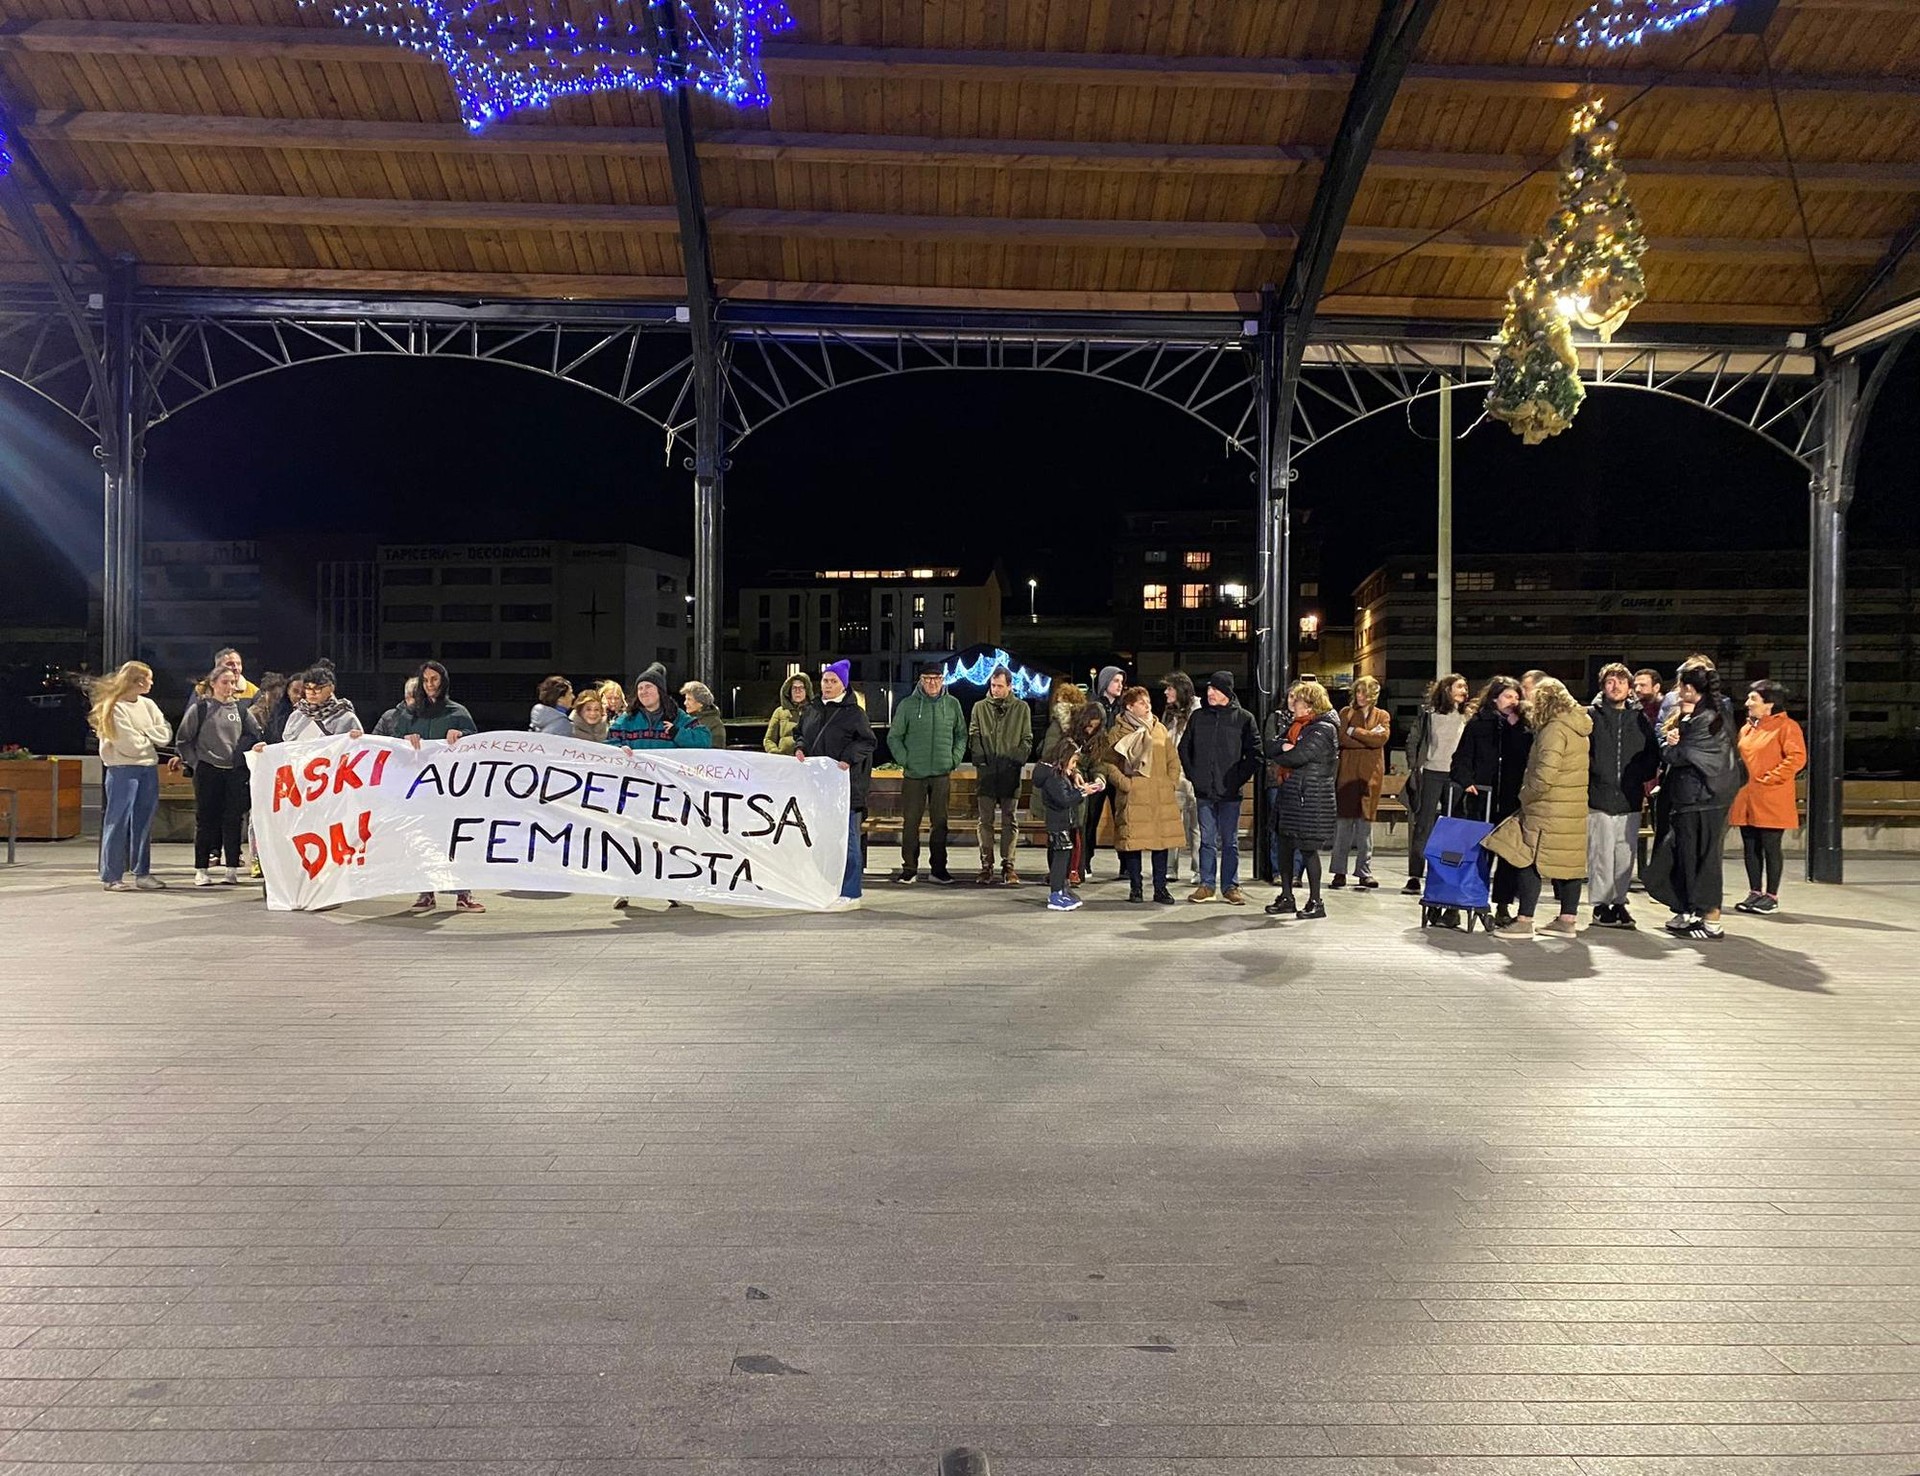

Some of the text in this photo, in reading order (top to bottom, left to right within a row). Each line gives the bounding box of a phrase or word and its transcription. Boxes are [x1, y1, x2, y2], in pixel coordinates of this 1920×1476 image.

[272, 749, 392, 813] ASKI
[437, 740, 546, 755] NDARKERIA
[562, 748, 657, 773] MATXISTEN
[405, 760, 814, 848] AUTODEFENTSA
[292, 810, 372, 881] DA!
